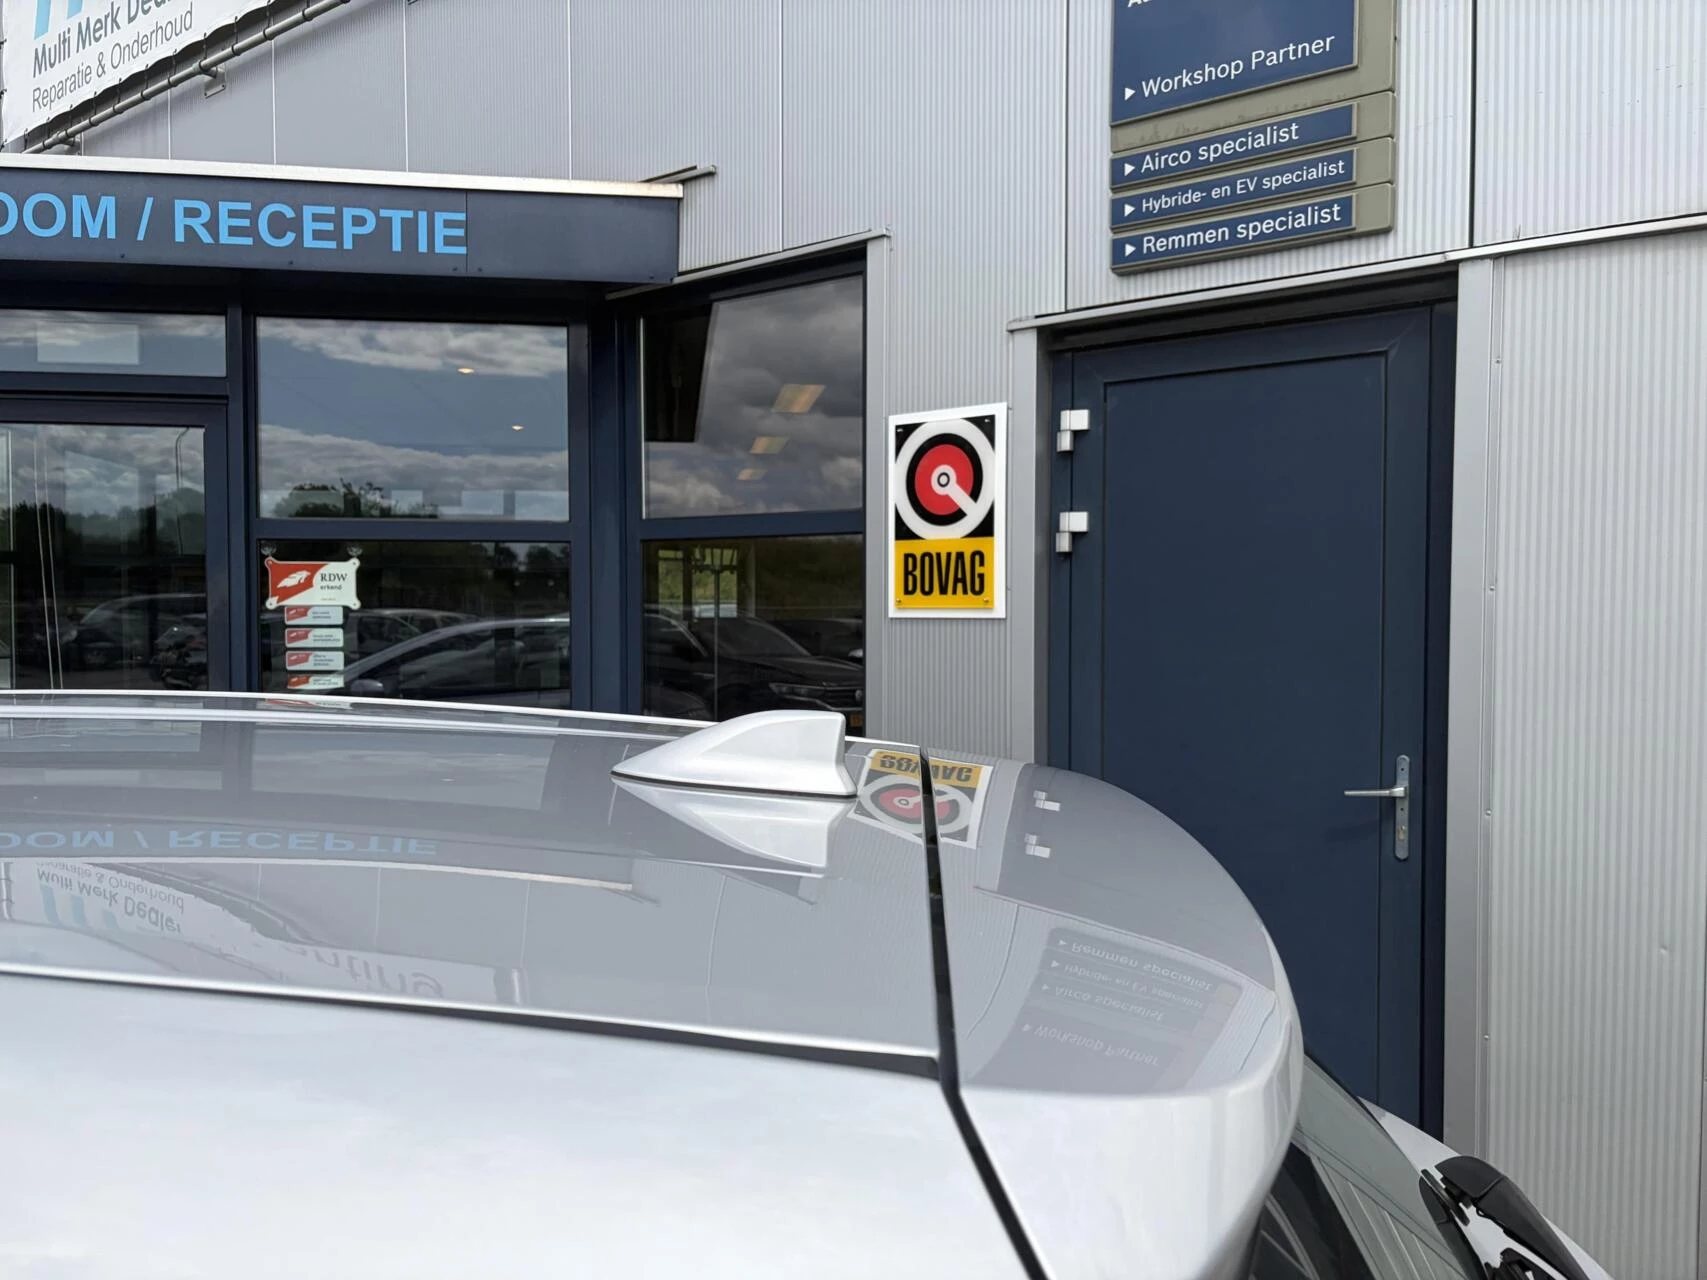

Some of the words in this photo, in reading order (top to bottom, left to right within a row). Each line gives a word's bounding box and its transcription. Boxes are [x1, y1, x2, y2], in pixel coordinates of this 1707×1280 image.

[32, 62, 92, 113] Reparatie
[96, 51, 106, 78] &
[110, 2, 193, 69] Onderhoud
[33, 27, 71, 78] Multi
[76, 1, 121, 53] Merk
[1141, 58, 1244, 98] Workshop
[1251, 35, 1335, 70] Partner
[1140, 149, 1191, 174] Airco
[1198, 122, 1300, 161] specialist
[1142, 189, 1207, 214] Hybride-
[1211, 185, 1231, 200] en
[1236, 177, 1258, 195] EV
[1262, 159, 1345, 190] specialist
[136, 197, 154, 241] /
[174, 199, 467, 254] RECEPTIE
[1142, 226, 1230, 255] Remmen
[1236, 203, 1341, 240] specialist
[320, 573, 348, 583] RDW
[903, 550, 985, 596] BOVAG
